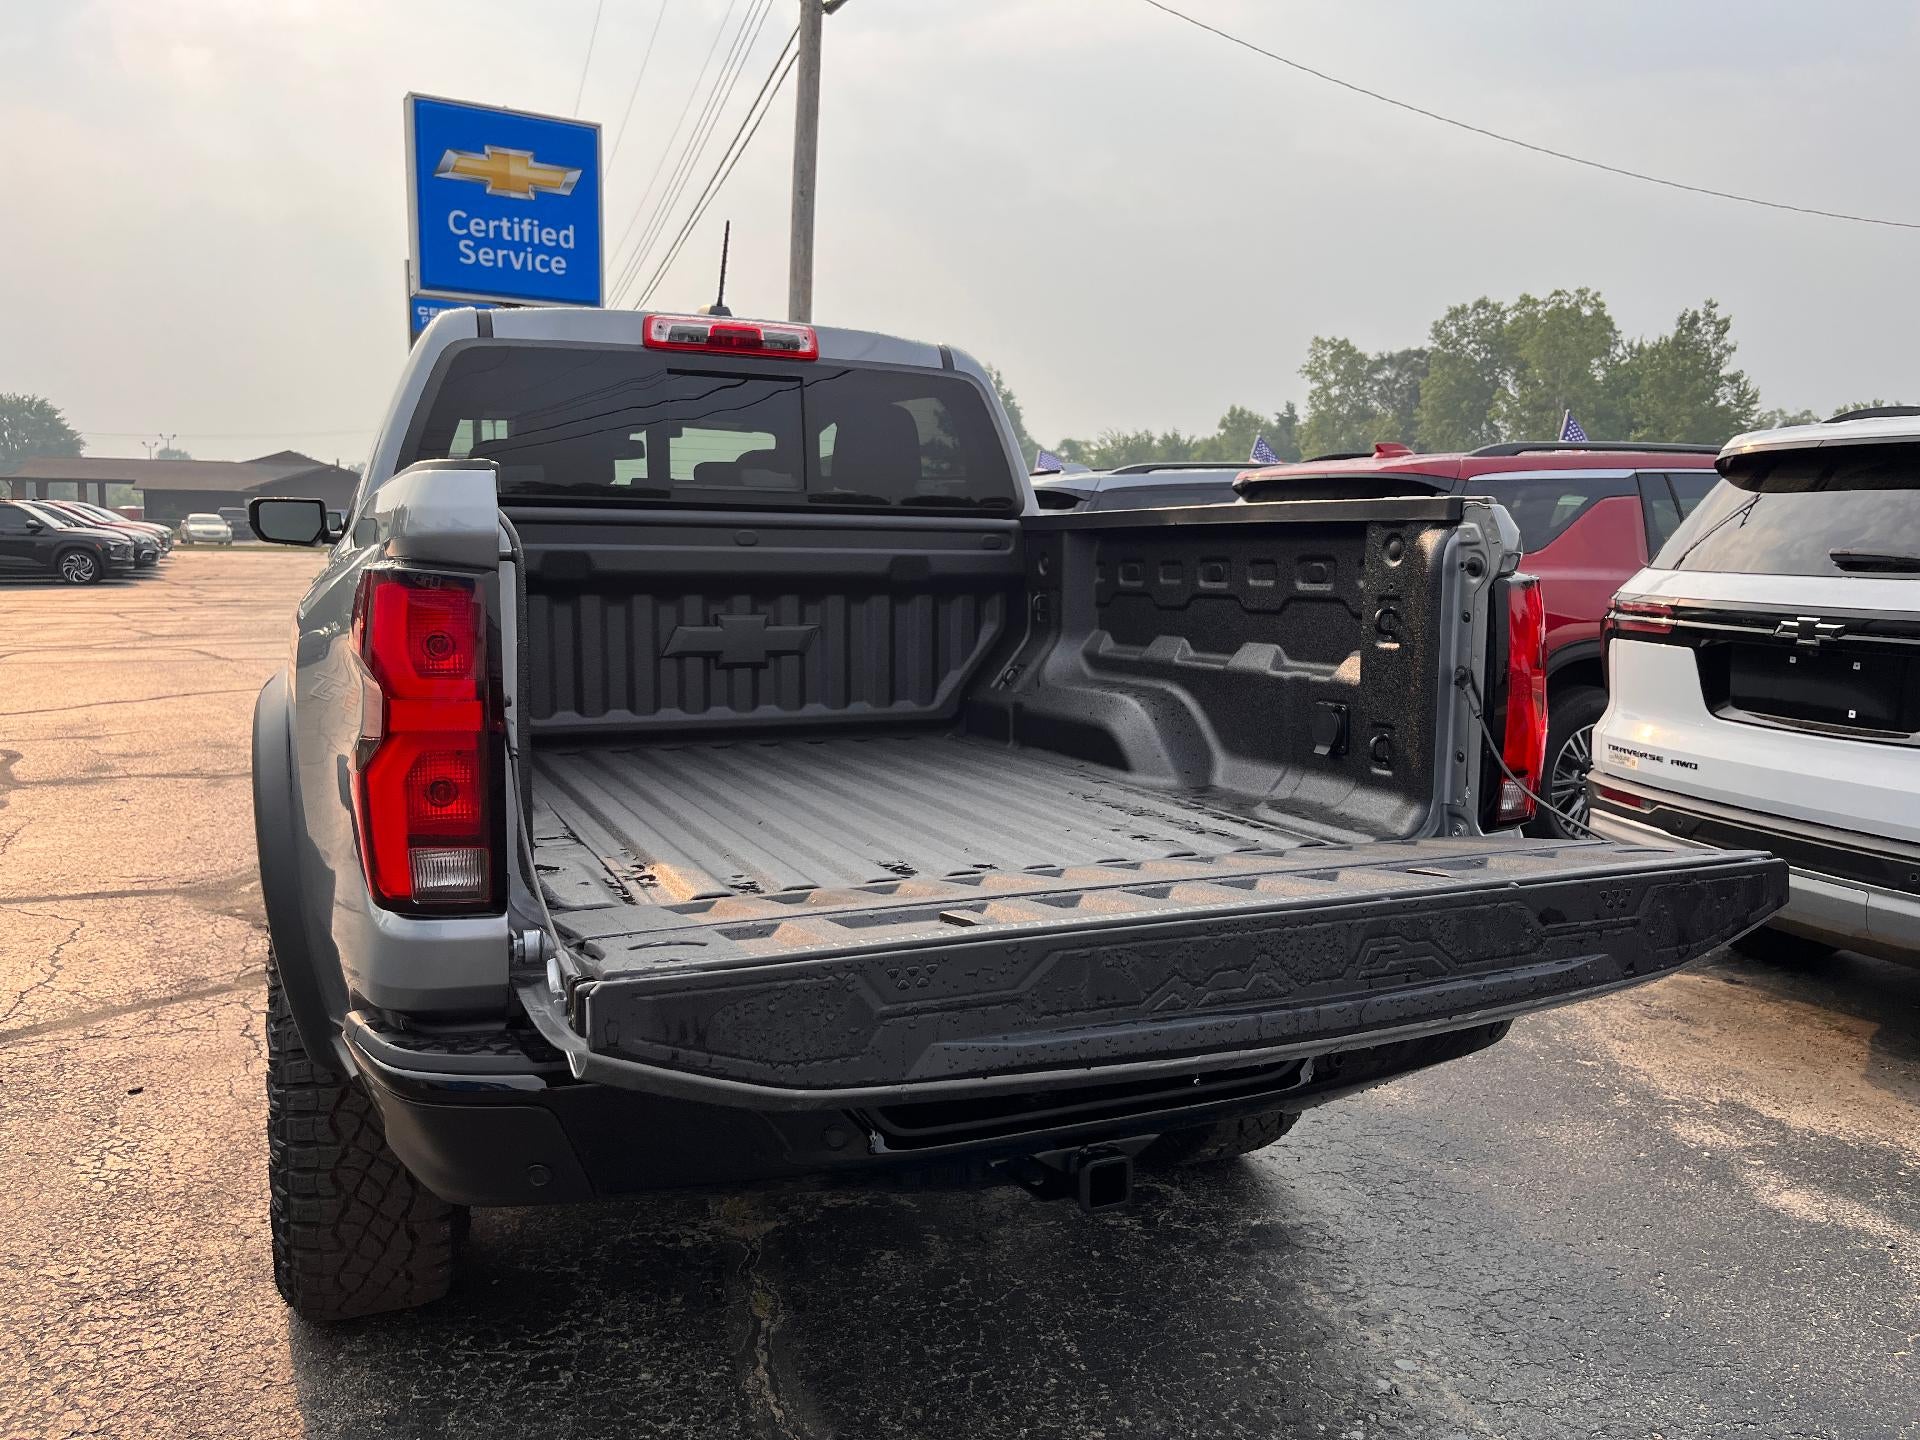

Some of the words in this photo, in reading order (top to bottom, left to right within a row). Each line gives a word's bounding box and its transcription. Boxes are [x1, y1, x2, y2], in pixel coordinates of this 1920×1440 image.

[448, 210, 575, 249] Certified
[459, 239, 567, 275] Service
[1607, 743, 1664, 763] TRAVERSE
[1670, 759, 1698, 770] AWD
